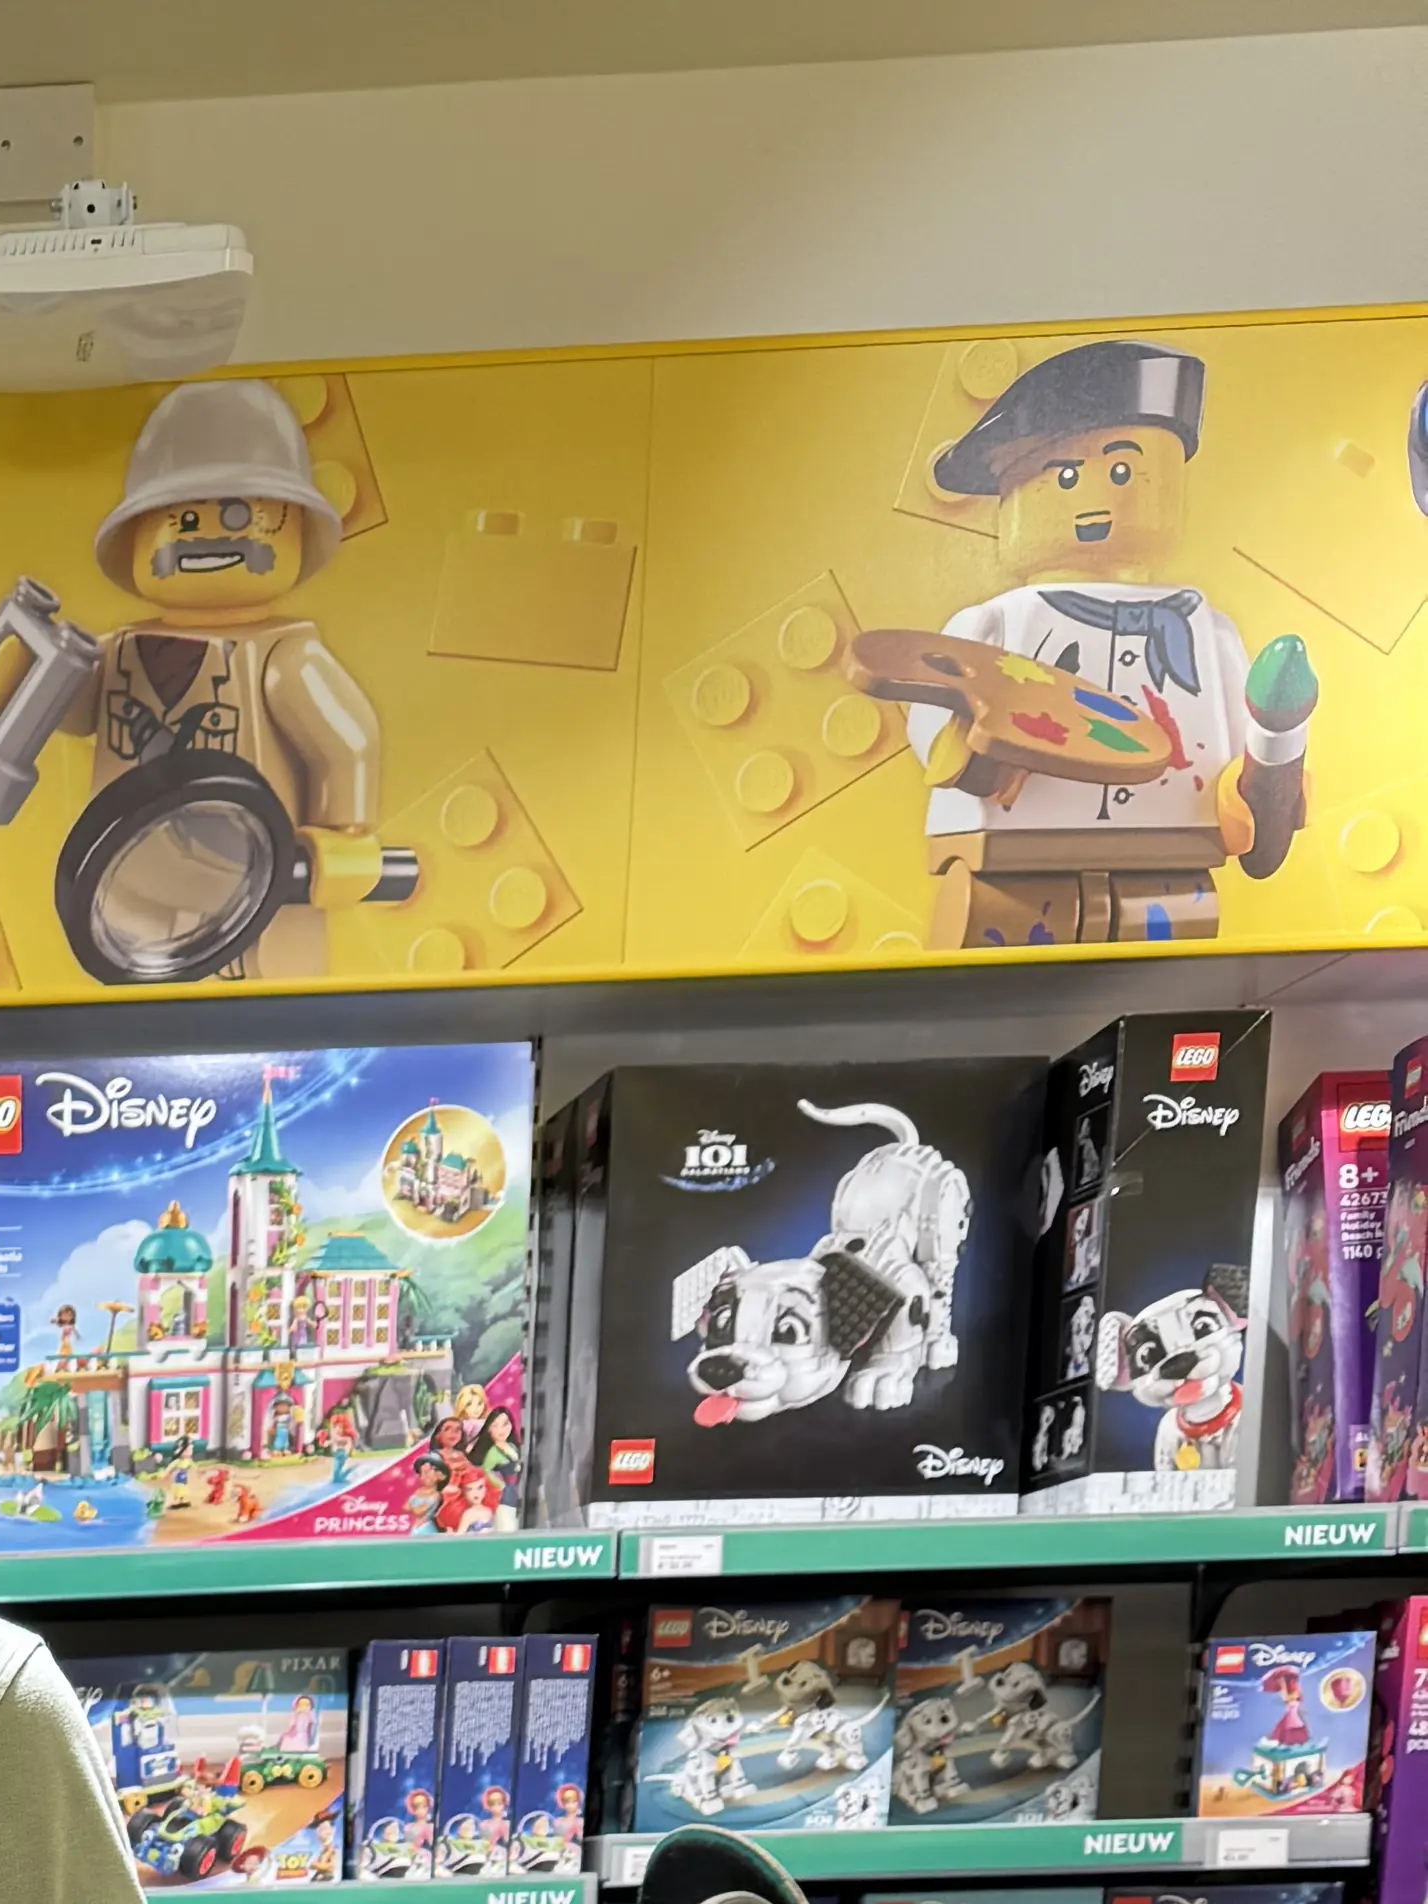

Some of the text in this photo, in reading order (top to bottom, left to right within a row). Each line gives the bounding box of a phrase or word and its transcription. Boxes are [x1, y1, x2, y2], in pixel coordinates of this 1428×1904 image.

[1173, 1045, 1217, 1070] LEGO
[1344, 1103, 1392, 1130] LEG
[684, 1144, 748, 1167] 101
[1339, 1163, 1380, 1189] 8+
[611, 1451, 652, 1474] LEGO
[314, 1513, 411, 1533] PRINCESS
[1283, 1522, 1377, 1548] NIEUW
[512, 1544, 604, 1570] NIEUW
[279, 1655, 341, 1673] PIXAR
[1083, 1831, 1174, 1855] NIEUW
[276, 1853, 309, 1871] TOY
